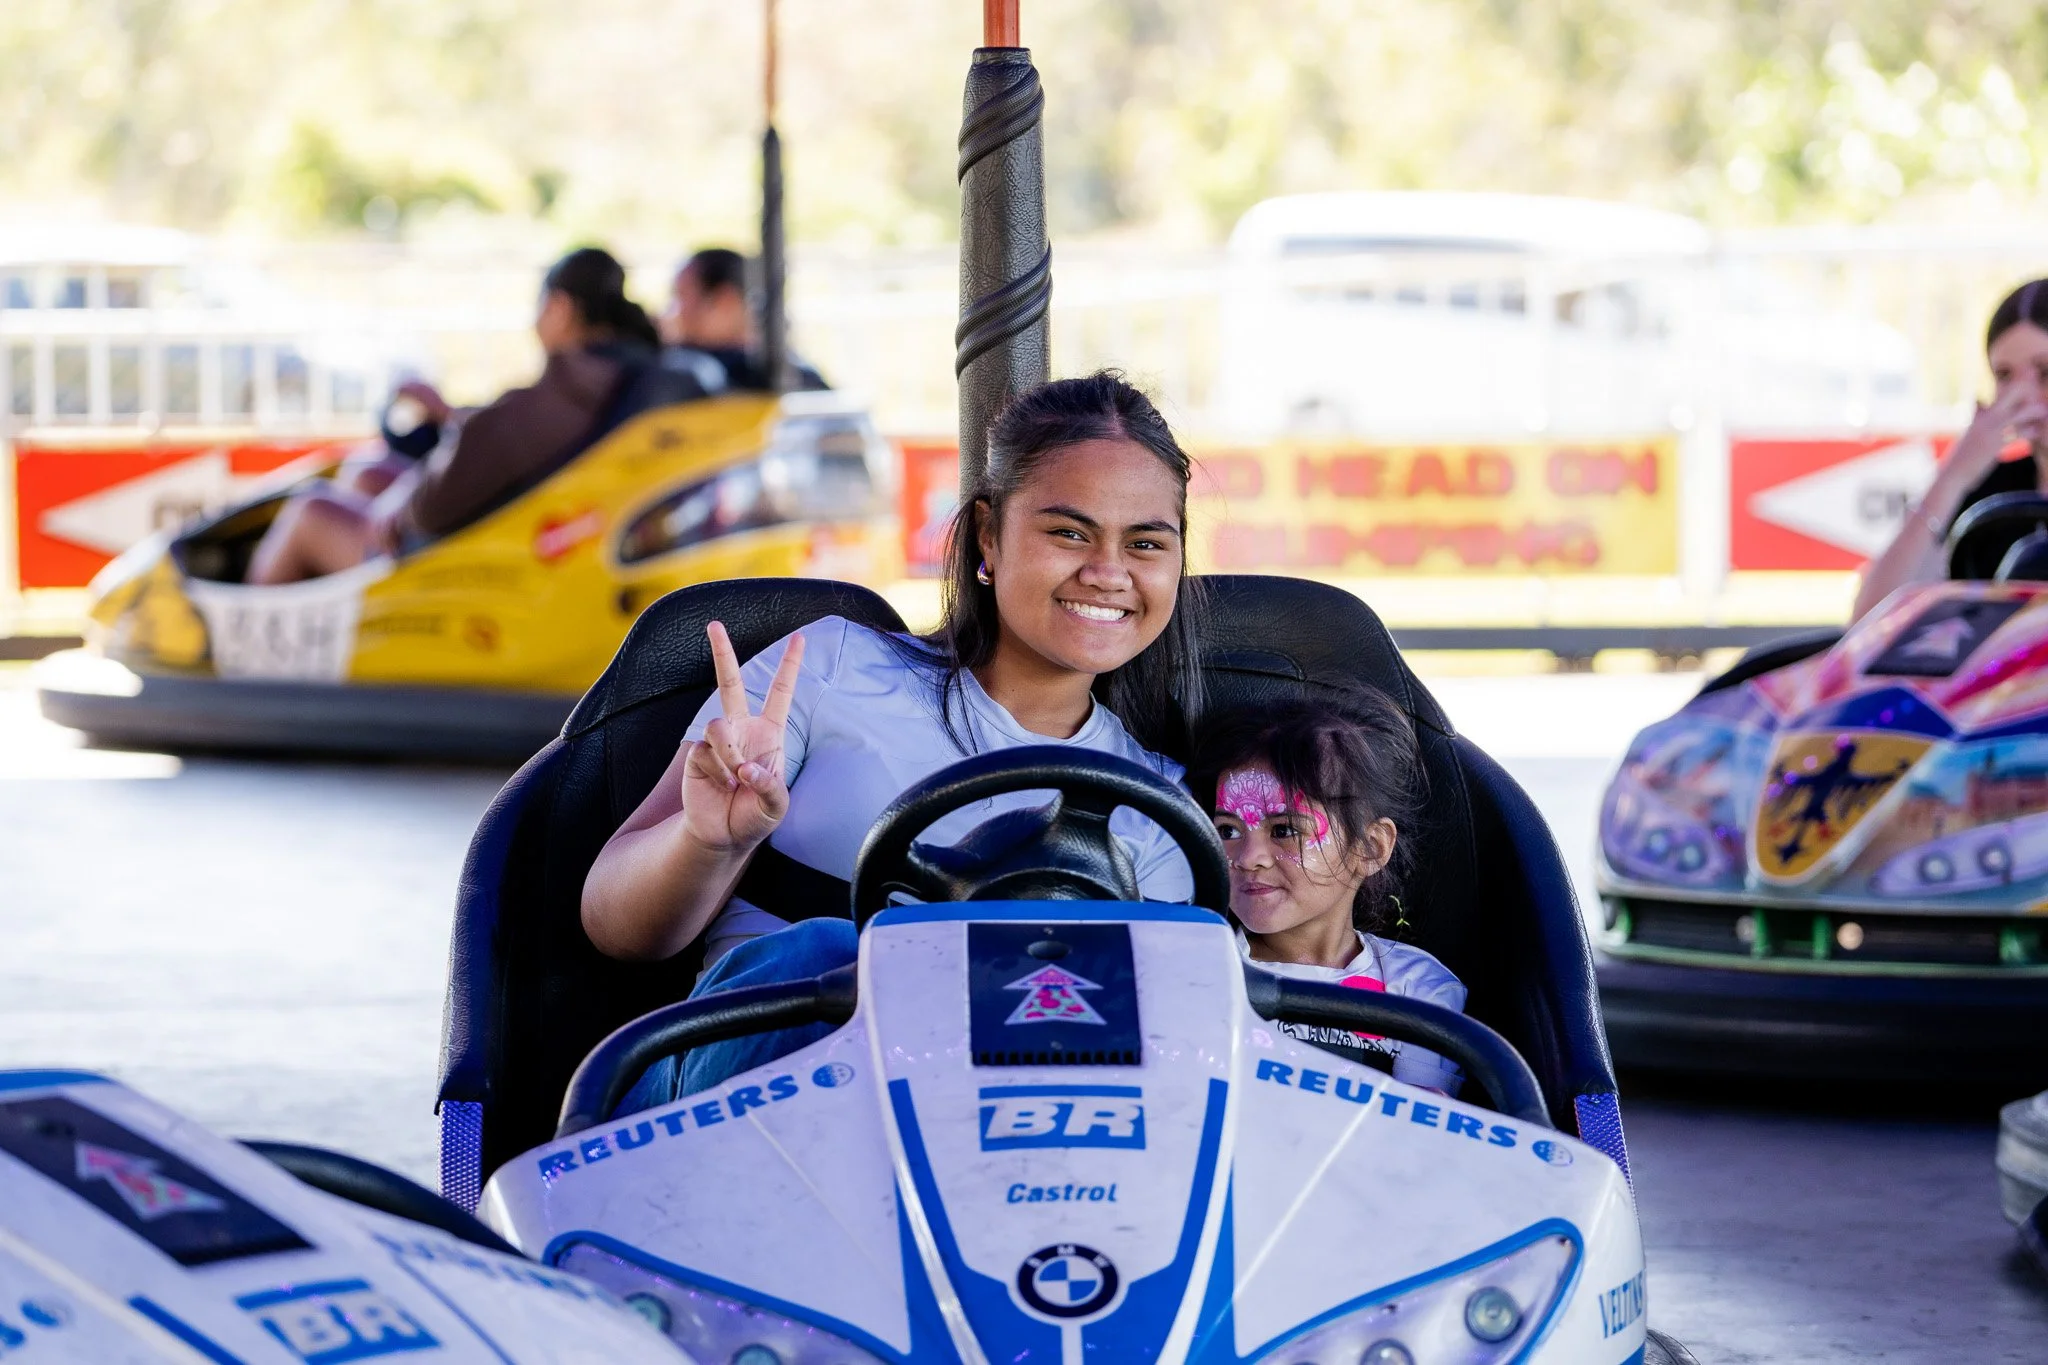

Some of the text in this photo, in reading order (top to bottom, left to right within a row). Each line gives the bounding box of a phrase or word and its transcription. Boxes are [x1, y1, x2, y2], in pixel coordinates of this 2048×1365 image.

[1296, 453, 1514, 498] HEAD
[538, 1074, 800, 1180] REUTERS
[985, 1101, 1141, 1140] BR
[1256, 1058, 1518, 1149] REUTERS
[1006, 1182, 1118, 1204] Castrol
[267, 1297, 424, 1357] BR
